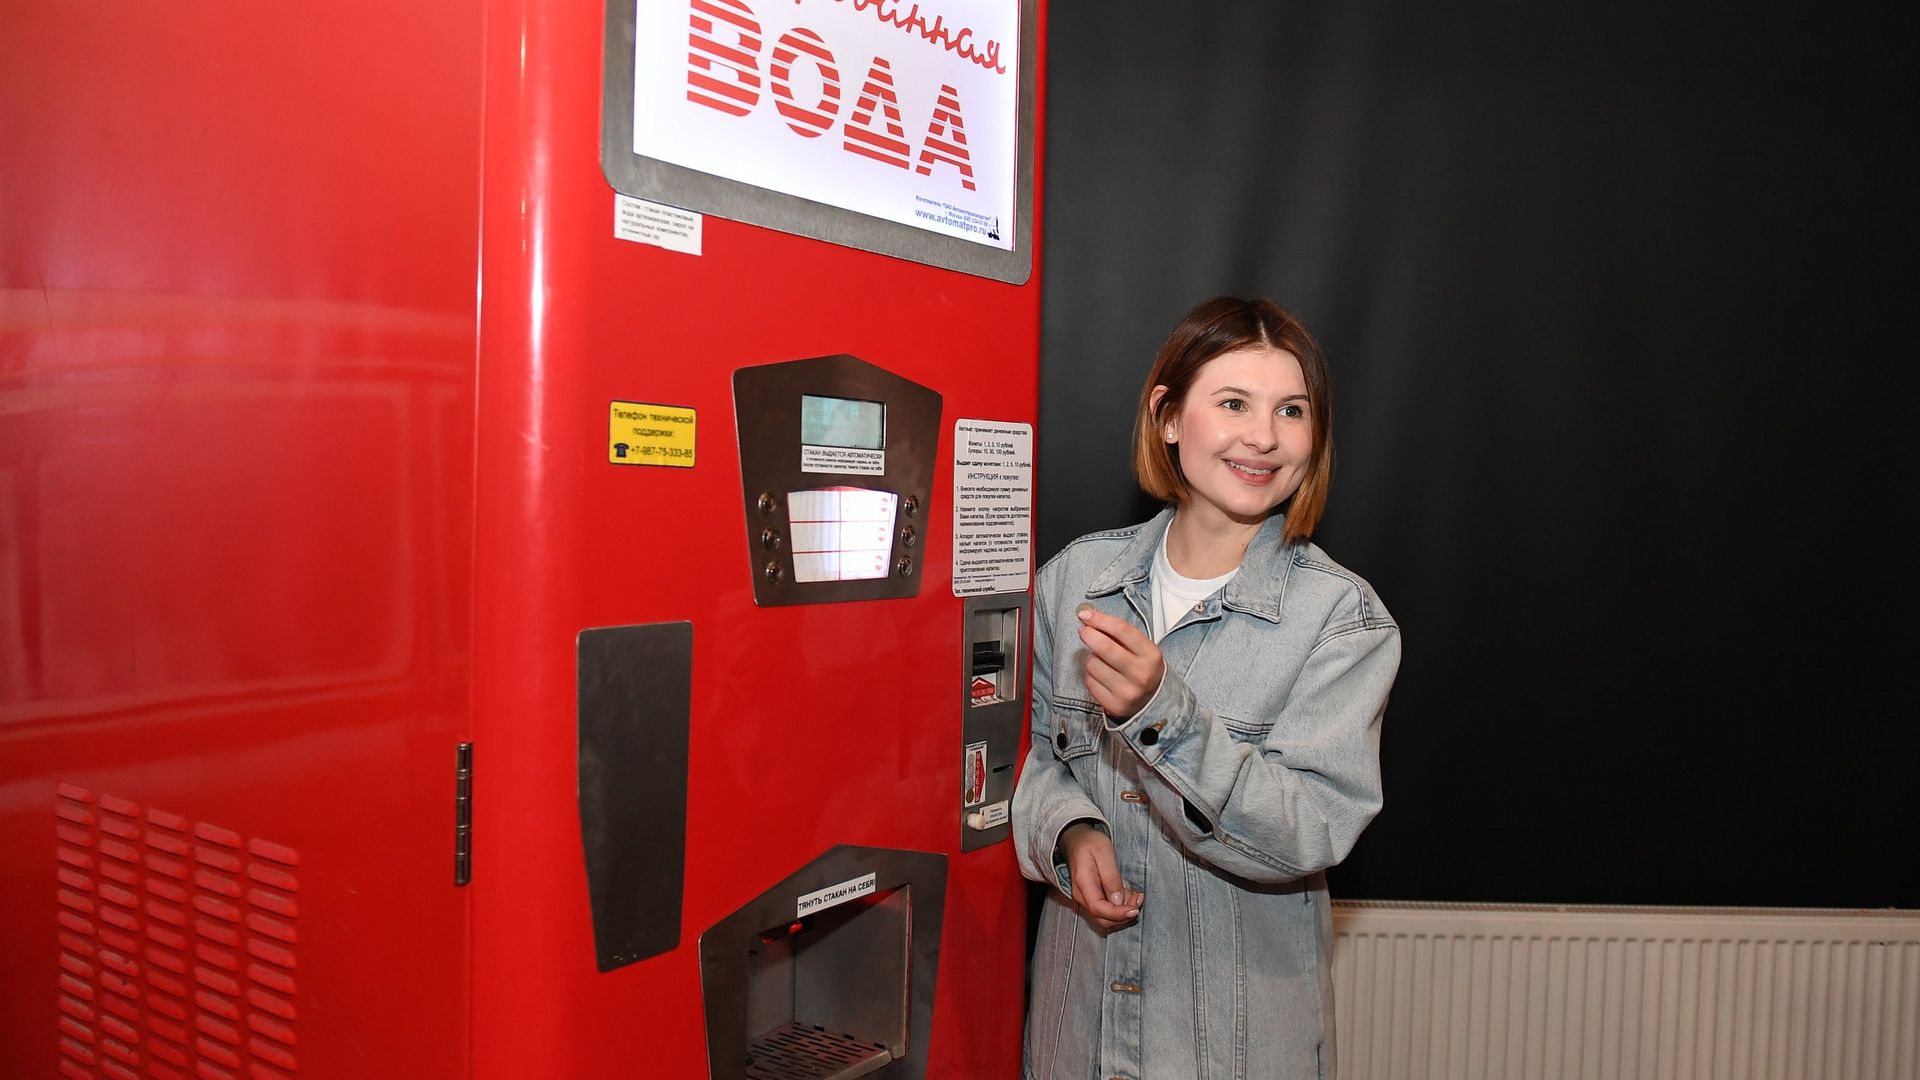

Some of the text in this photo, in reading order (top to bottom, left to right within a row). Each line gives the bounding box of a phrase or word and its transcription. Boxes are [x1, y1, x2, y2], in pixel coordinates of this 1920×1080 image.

[687, 0, 976, 192] ВОДА
[915, 209, 986, 235] www.avtomatpro.ru
[613, 408, 693, 424] Телефон технической
[967, 472, 998, 481] ИНСТРУКЦИЯ
[798, 897, 822, 911] ТЯНУТЬ
[824, 888, 847, 902] СТАКАН
[848, 886, 857, 894] НА
